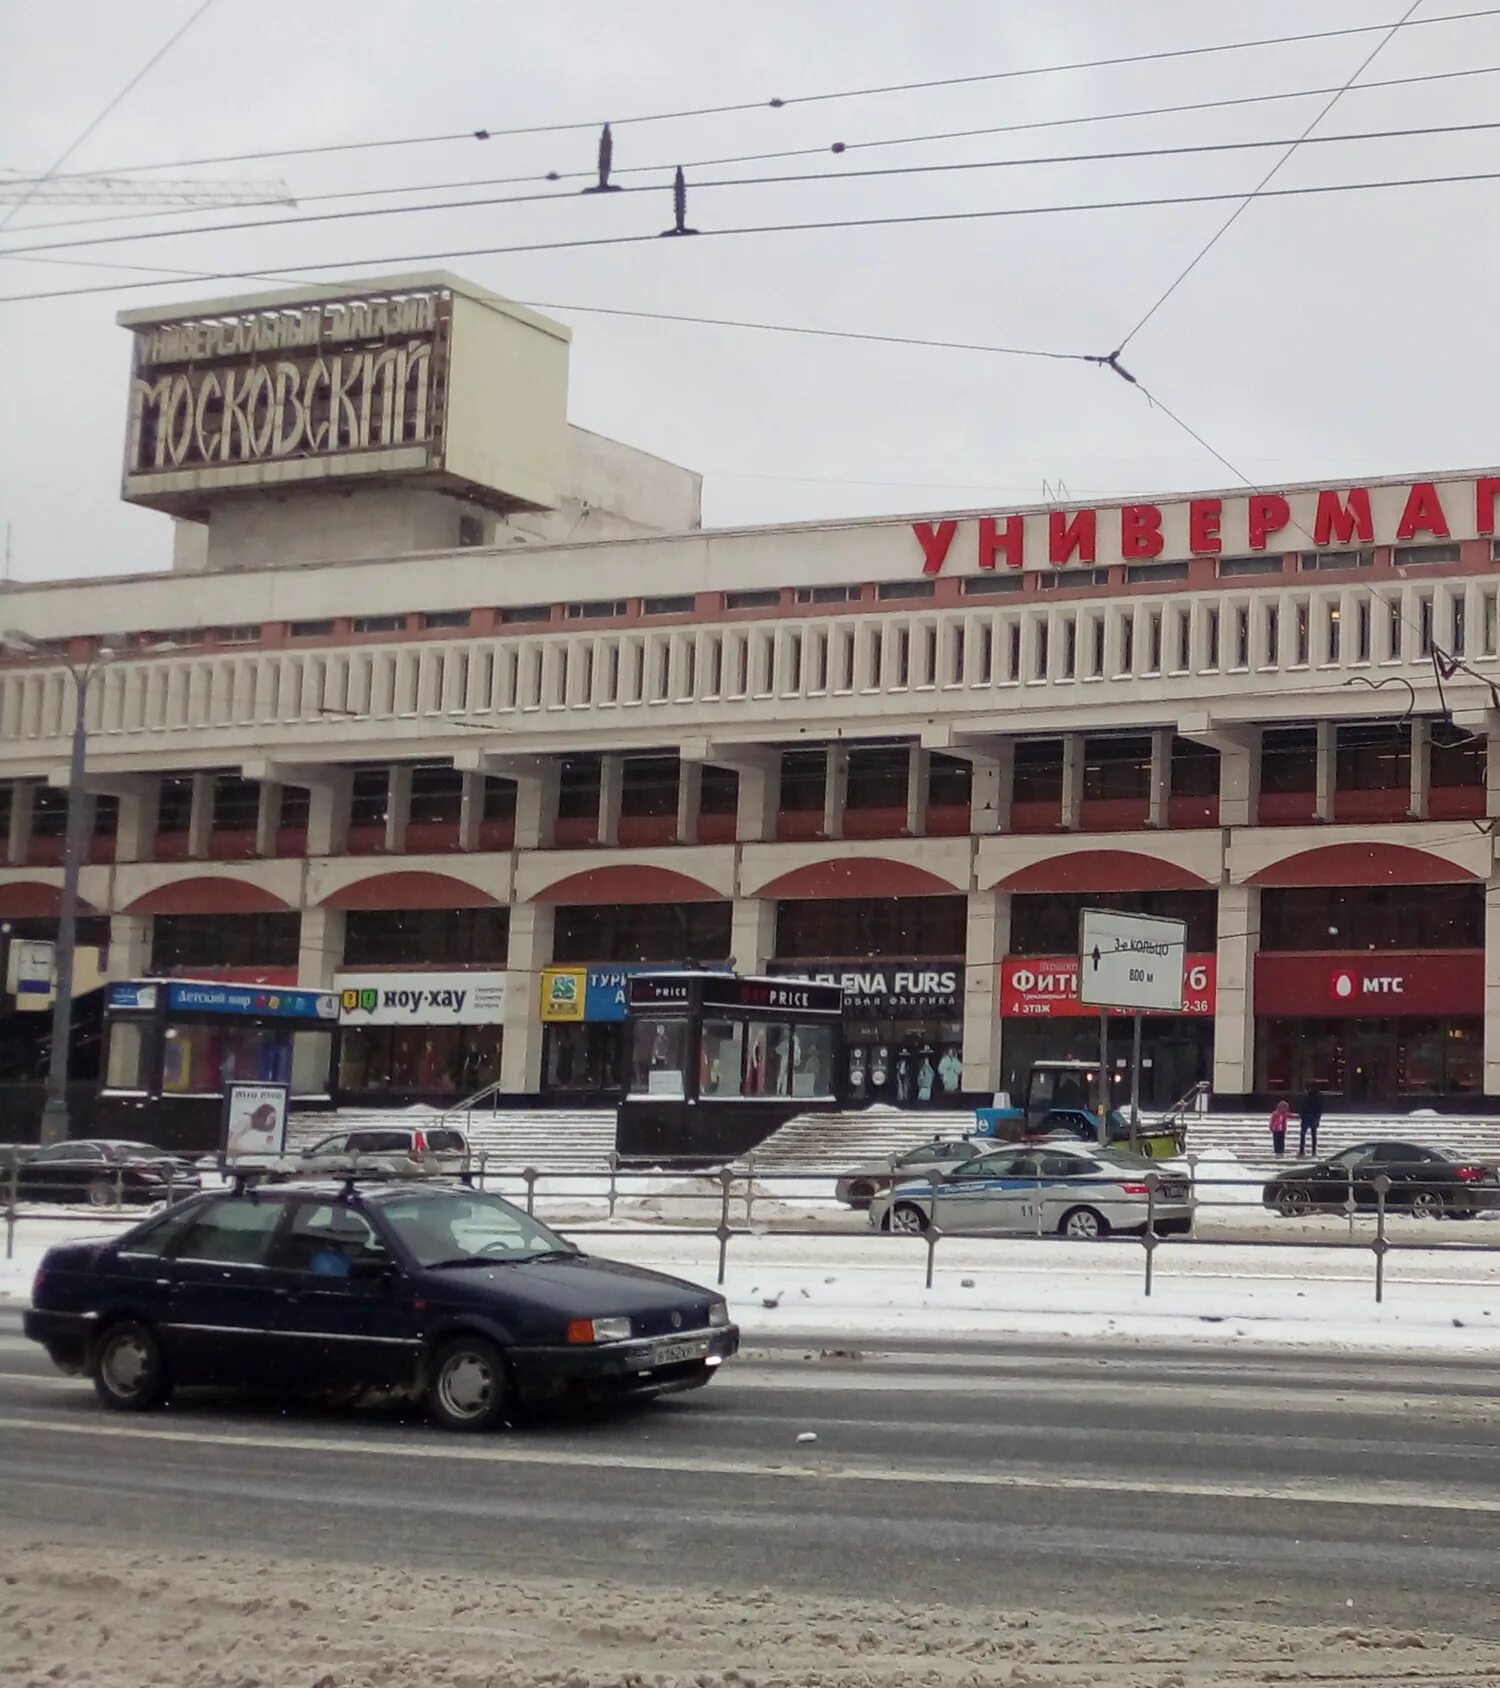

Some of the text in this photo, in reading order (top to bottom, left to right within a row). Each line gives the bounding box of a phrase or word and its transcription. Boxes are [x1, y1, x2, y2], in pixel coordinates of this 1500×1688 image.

[130, 340, 432, 471] МОСКОВСКИЙ
[1130, 939, 1169, 958] КОЛЬЦО
[895, 972, 957, 994] FURS
[1129, 969, 1145, 982] 800
[656, 987, 687, 997] PRICE
[1363, 977, 1404, 993] МТС
[769, 990, 808, 1007] PRICE
[889, 996, 956, 1006] ФАБРИКА
